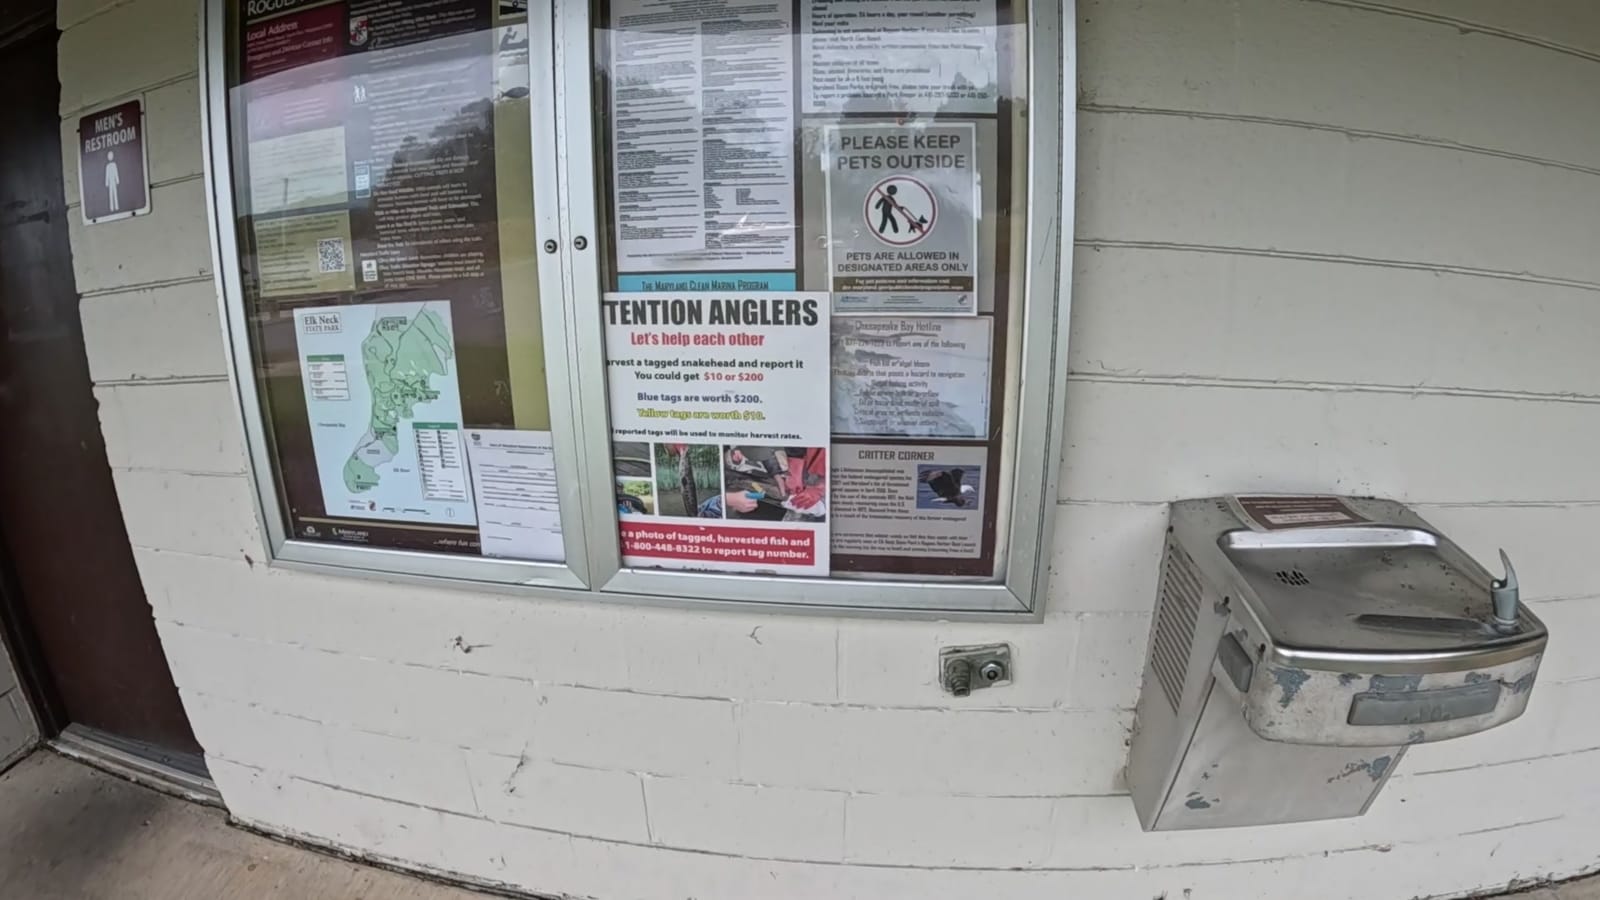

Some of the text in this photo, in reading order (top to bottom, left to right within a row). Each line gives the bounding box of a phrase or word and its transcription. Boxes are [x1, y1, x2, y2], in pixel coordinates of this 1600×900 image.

[248, 0, 295, 16] ROGU
[247, 28, 266, 41] Local
[268, 21, 298, 35] Address
[95, 111, 123, 133] MEN'S
[85, 126, 136, 153] RESTROOM
[841, 134, 961, 150] PLEASE KEEP
[837, 154, 965, 170] PETS OUTSIDE
[846, 251, 959, 261] PETS ARE ALLOWED IN
[838, 263, 968, 272] DESIGNATED AREAS ONLY
[737, 280, 769, 291] PROGRAM
[603, 299, 818, 326] TENTION ANGLERS
[304, 314, 339, 325] Elk Neck
[855, 320, 942, 333] Chesapeake Bay Hotline
[631, 332, 765, 347] Let's help each other
[605, 358, 634, 367] arvest
[644, 359, 679, 370] tagged
[681, 358, 736, 368] snakehead
[738, 359, 757, 368] and
[760, 360, 794, 371] report
[795, 359, 803, 369] it
[634, 371, 652, 380] You
[654, 371, 681, 381] could
[683, 373, 699, 383] get
[703, 372, 723, 382] $10
[738, 373, 763, 382] $200
[637, 392, 659, 402] Blue
[661, 393, 682, 404] tags
[702, 394, 731, 403] worth
[734, 394, 762, 405] $200.
[637, 408, 766, 421] Yellow tags are worth $10.
[615, 428, 646, 438] reported
[647, 429, 664, 438] tags
[718, 430, 749, 438] monitor
[750, 431, 779, 439] harvest
[780, 432, 803, 440] rates.
[858, 450, 935, 461] CRITTER CORNER
[635, 530, 664, 540] photo
[666, 531, 677, 540] of
[678, 532, 715, 544] tagged,
[717, 534, 769, 546] harvested
[769, 535, 789, 546] fish
[790, 536, 810, 547] and
[625, 541, 809, 560] 1-800-448-8322 to report tag number.
